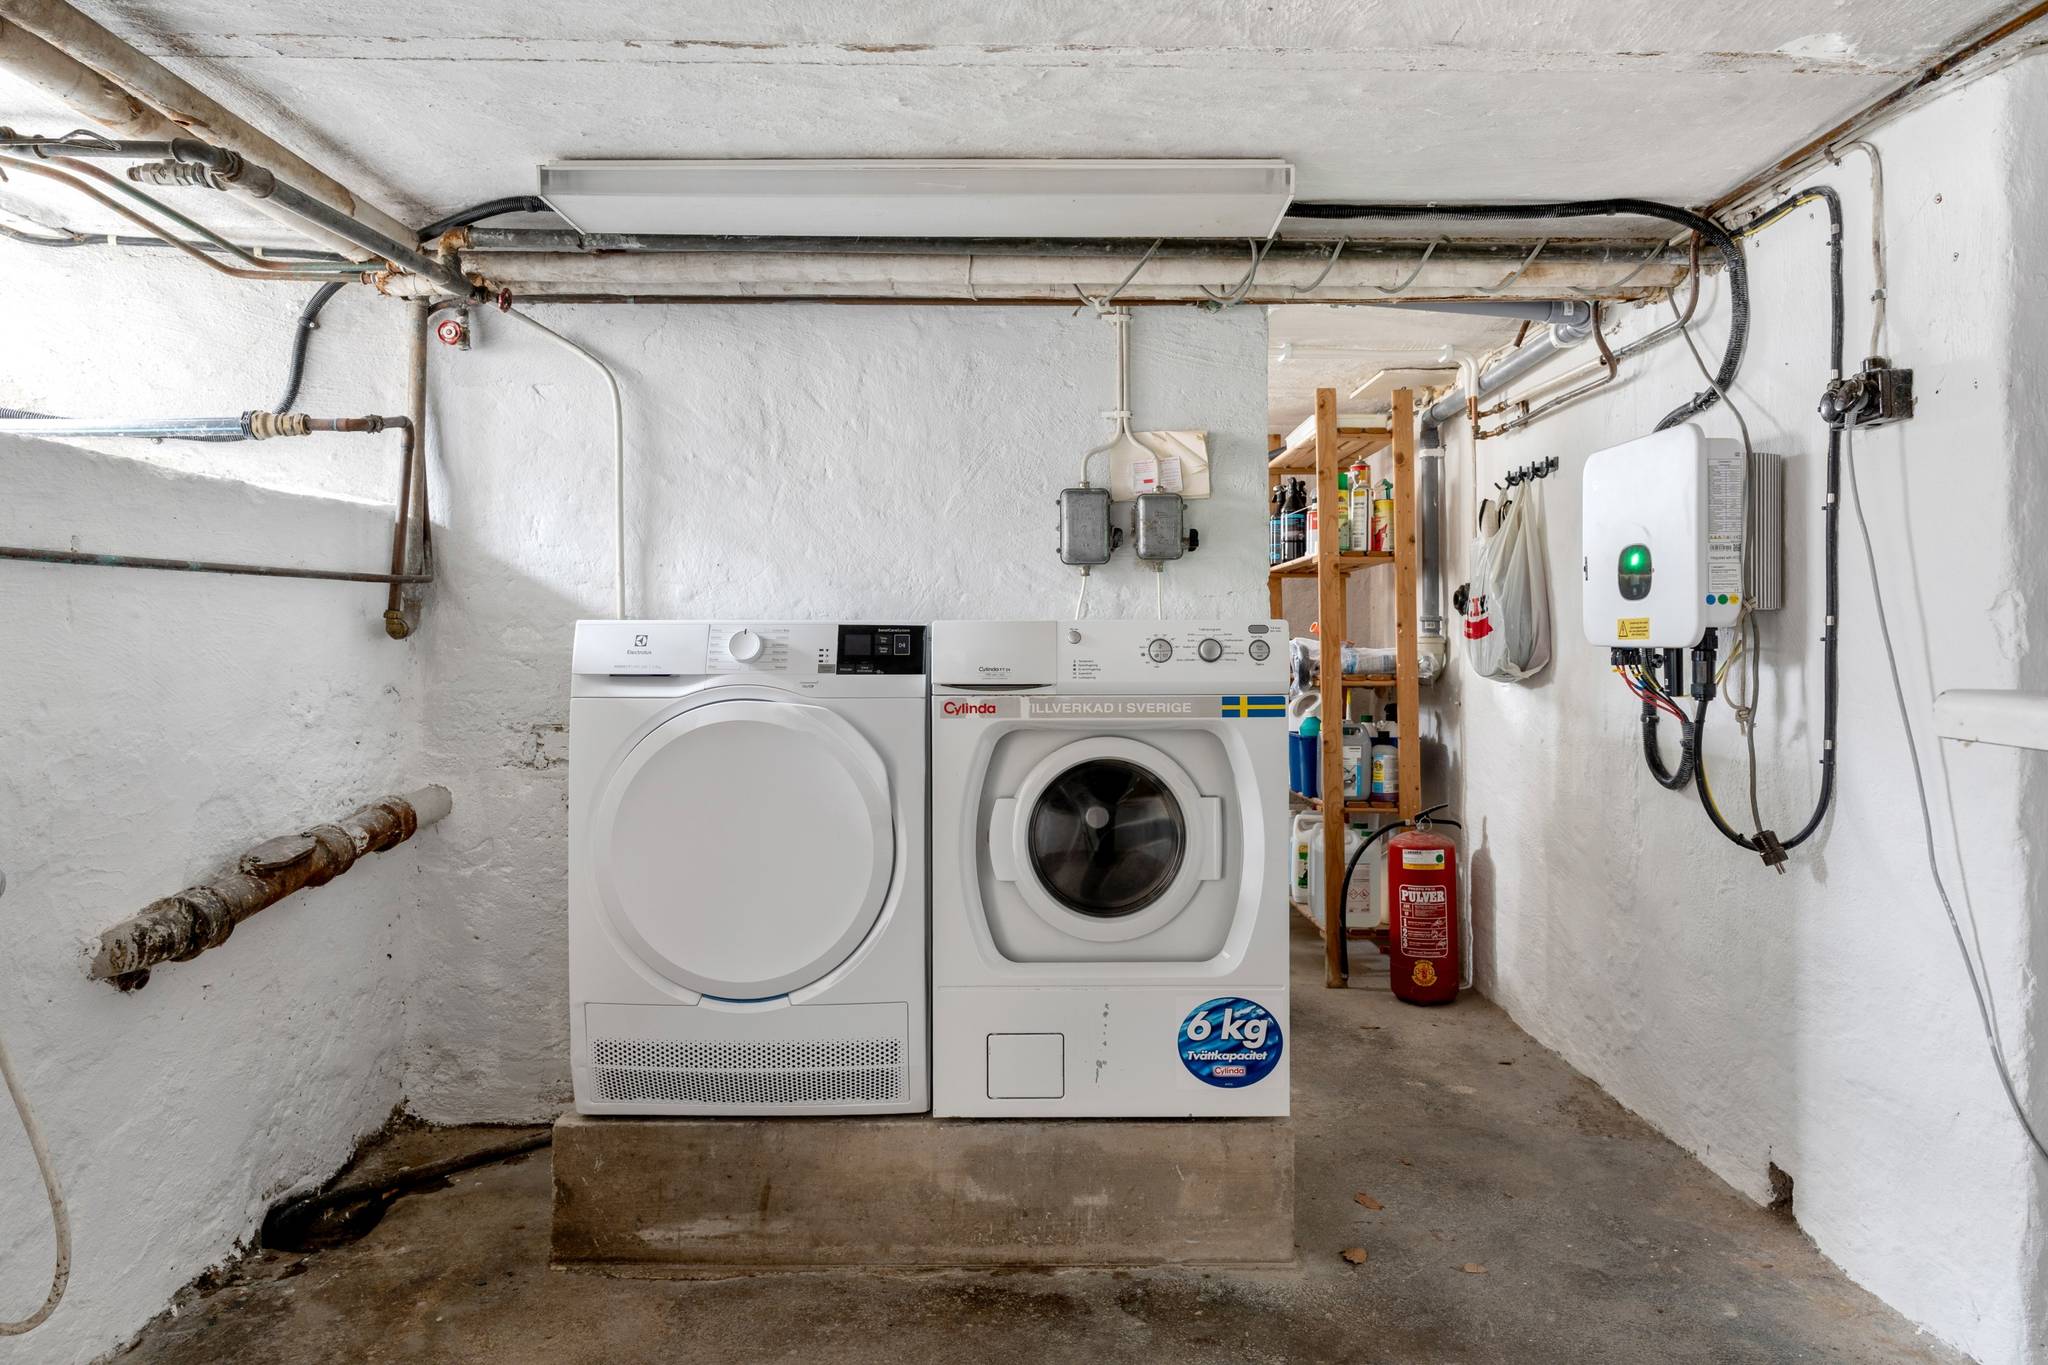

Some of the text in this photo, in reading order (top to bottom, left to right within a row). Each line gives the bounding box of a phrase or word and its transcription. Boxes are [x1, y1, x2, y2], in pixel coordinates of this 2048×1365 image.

[944, 701, 1192, 715] Cylinda ILLVERKAD I SVERIGE
[1401, 889, 1445, 903] PULVER
[1402, 928, 1408, 938] 2
[1187, 1008, 1268, 1049] 6 kg
[1187, 1050, 1268, 1063] Tvättkapacitet
[1214, 1066, 1245, 1075] Cylinda
